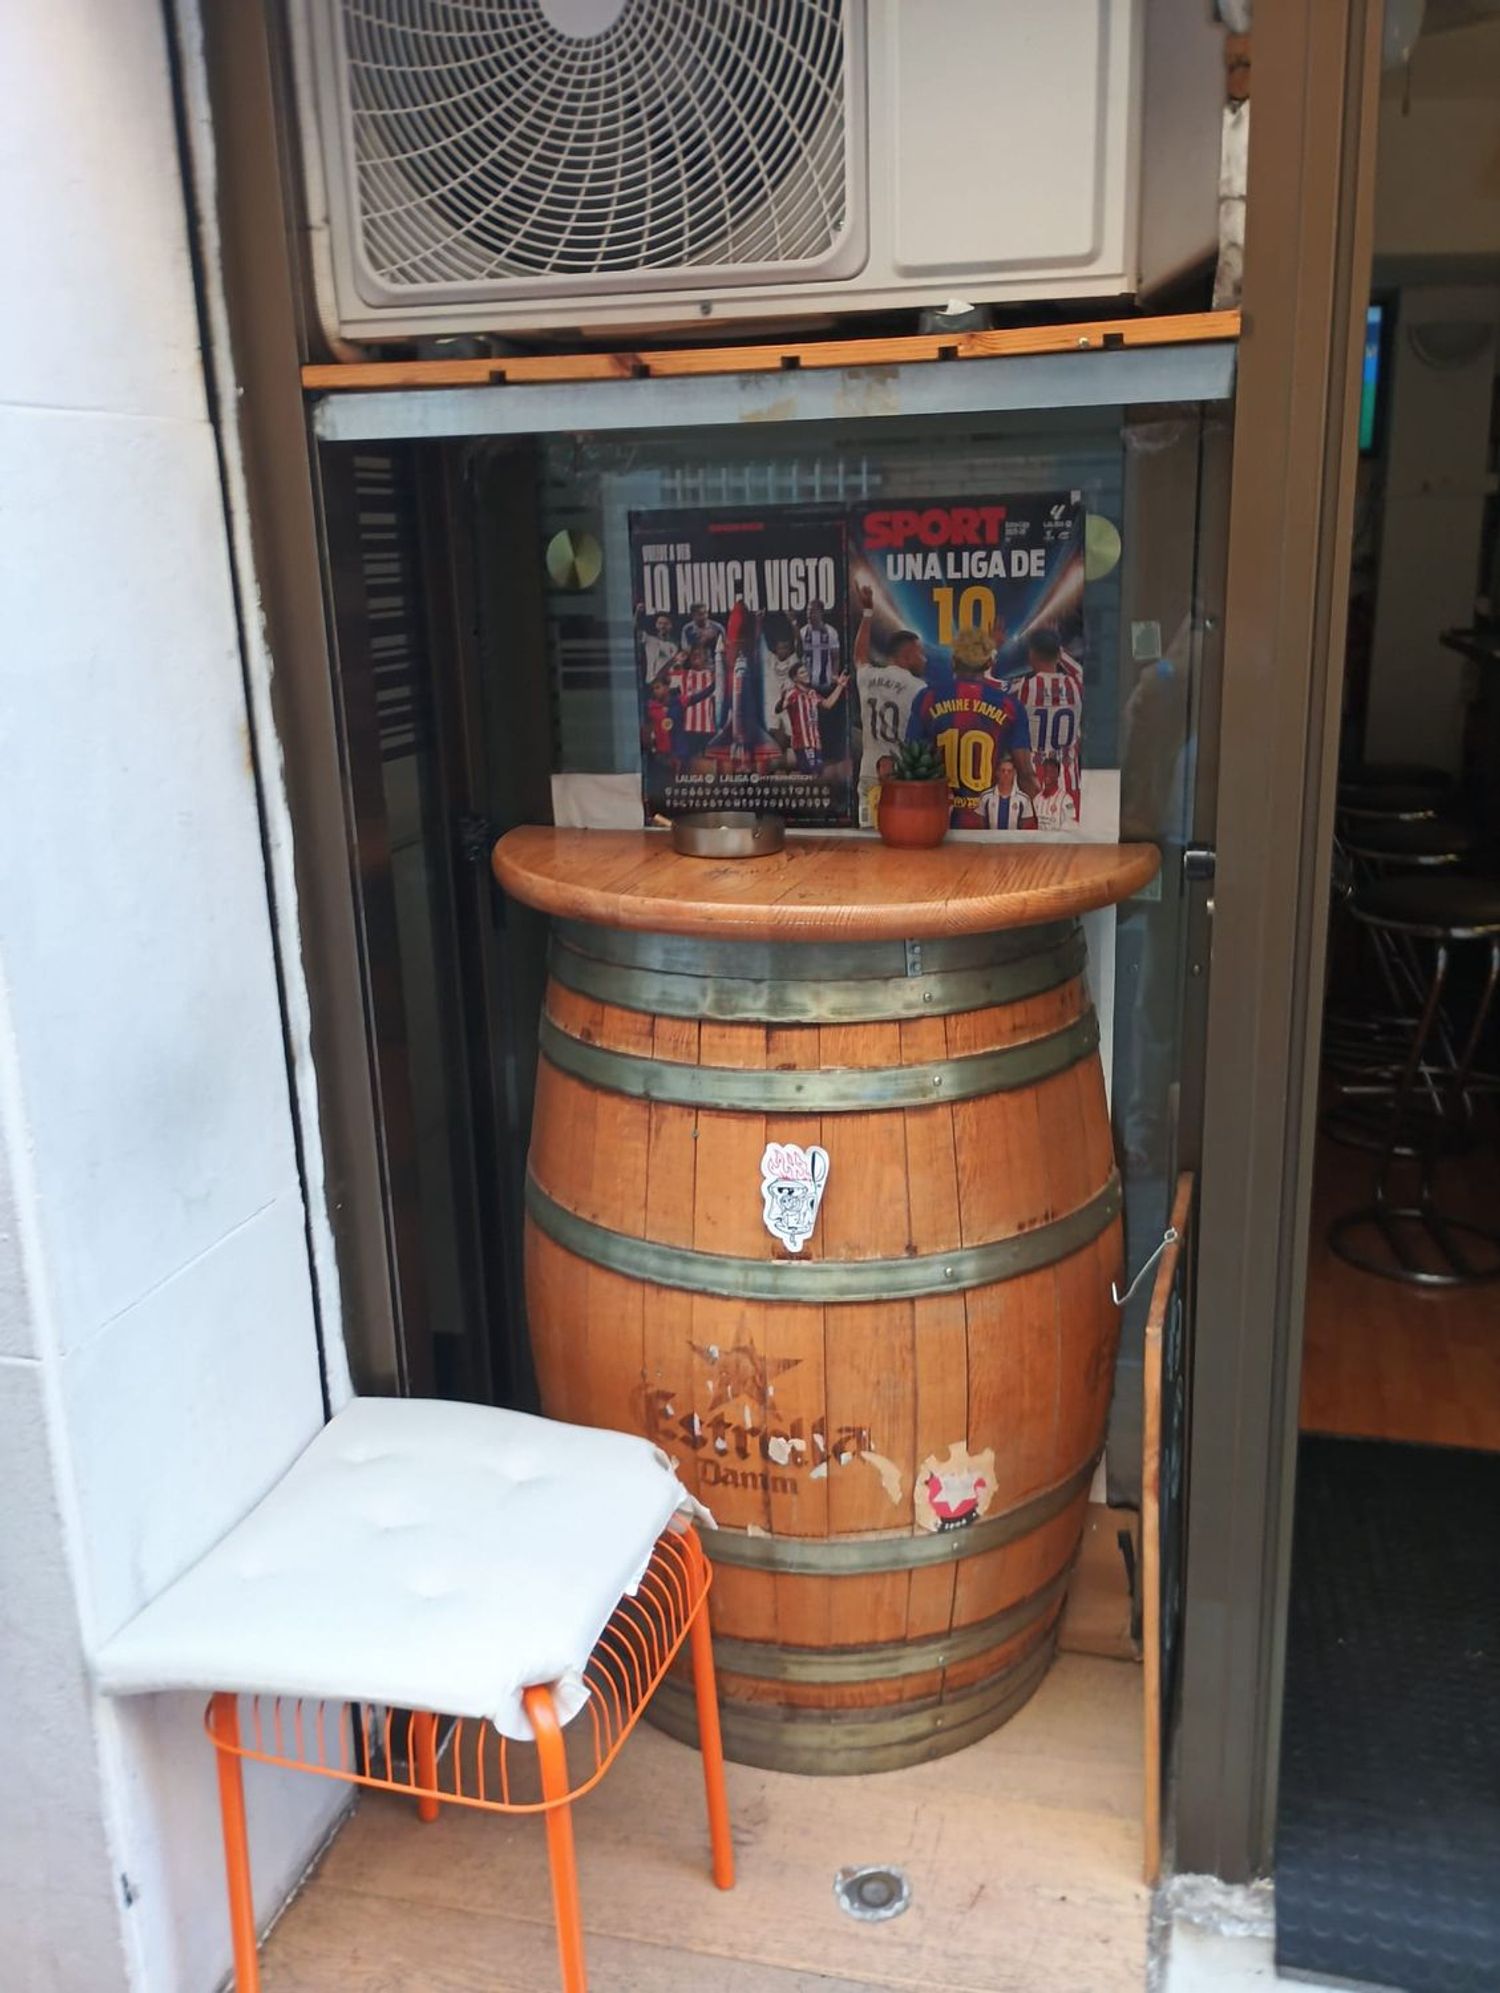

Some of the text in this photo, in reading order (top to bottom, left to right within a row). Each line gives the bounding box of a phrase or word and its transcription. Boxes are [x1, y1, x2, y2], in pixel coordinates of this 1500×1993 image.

[863, 505, 1006, 549] SPORT
[643, 556, 835, 616] LO NUNCA VISTO
[886, 549, 1045, 581] UNA LIGA DE
[932, 585, 996, 646] 10
[867, 697, 900, 744] 10
[1033, 707, 1075, 751] 10
[937, 728, 995, 792] 10
[696, 1457, 799, 1496] Damm
